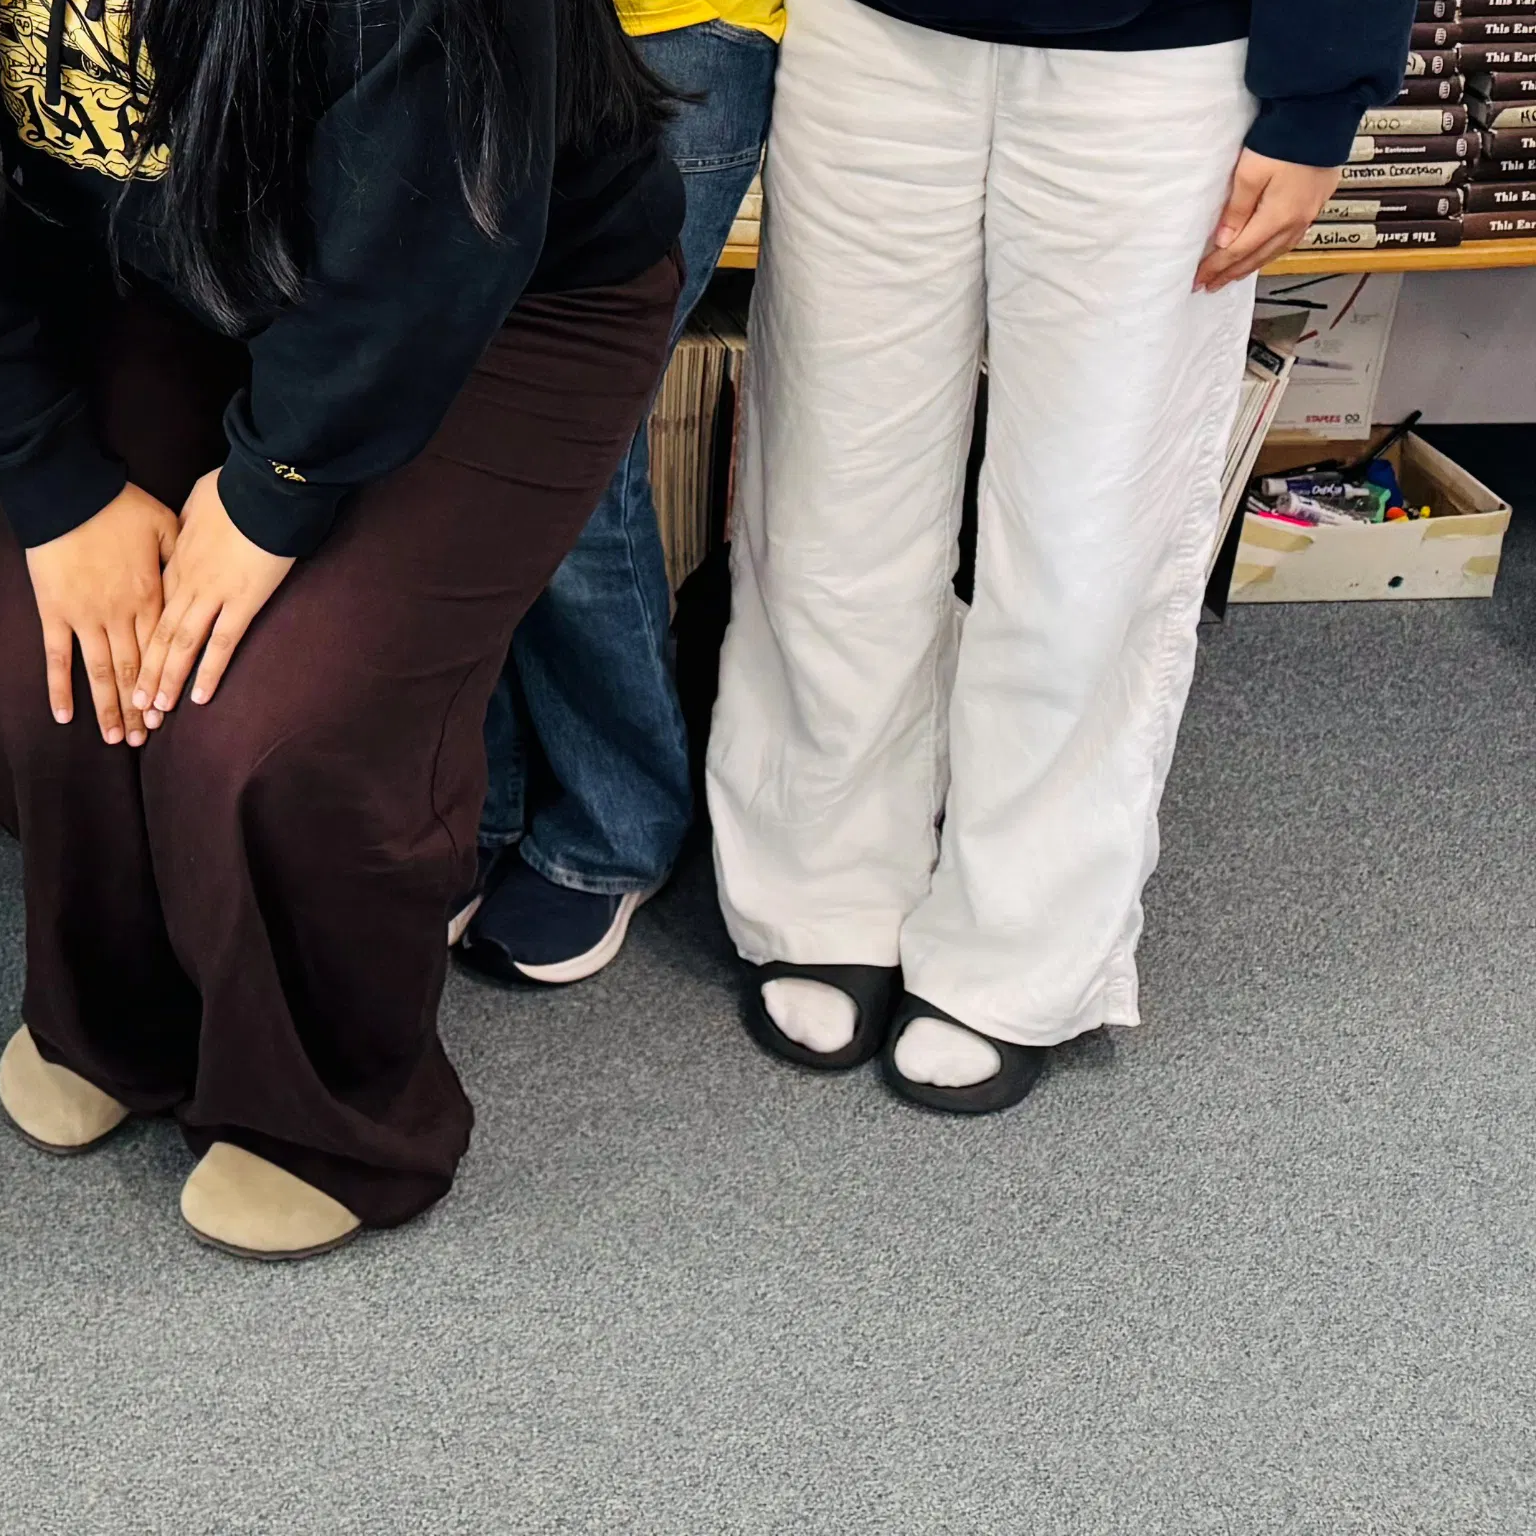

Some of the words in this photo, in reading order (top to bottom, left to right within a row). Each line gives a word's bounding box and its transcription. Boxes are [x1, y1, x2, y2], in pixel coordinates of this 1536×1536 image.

[1485, 23, 1510, 34] This
[1485, 51, 1510, 62] This
[1520, 80, 1536, 91] Th
[1500, 160, 1524, 171] This
[1527, 159, 1536, 170] E
[1494, 191, 1518, 202] This
[1489, 220, 1513, 231] This
[1377, 232, 1409, 243] Earth
[1413, 231, 1437, 242] This
[1305, 414, 1341, 424] STAPLES
